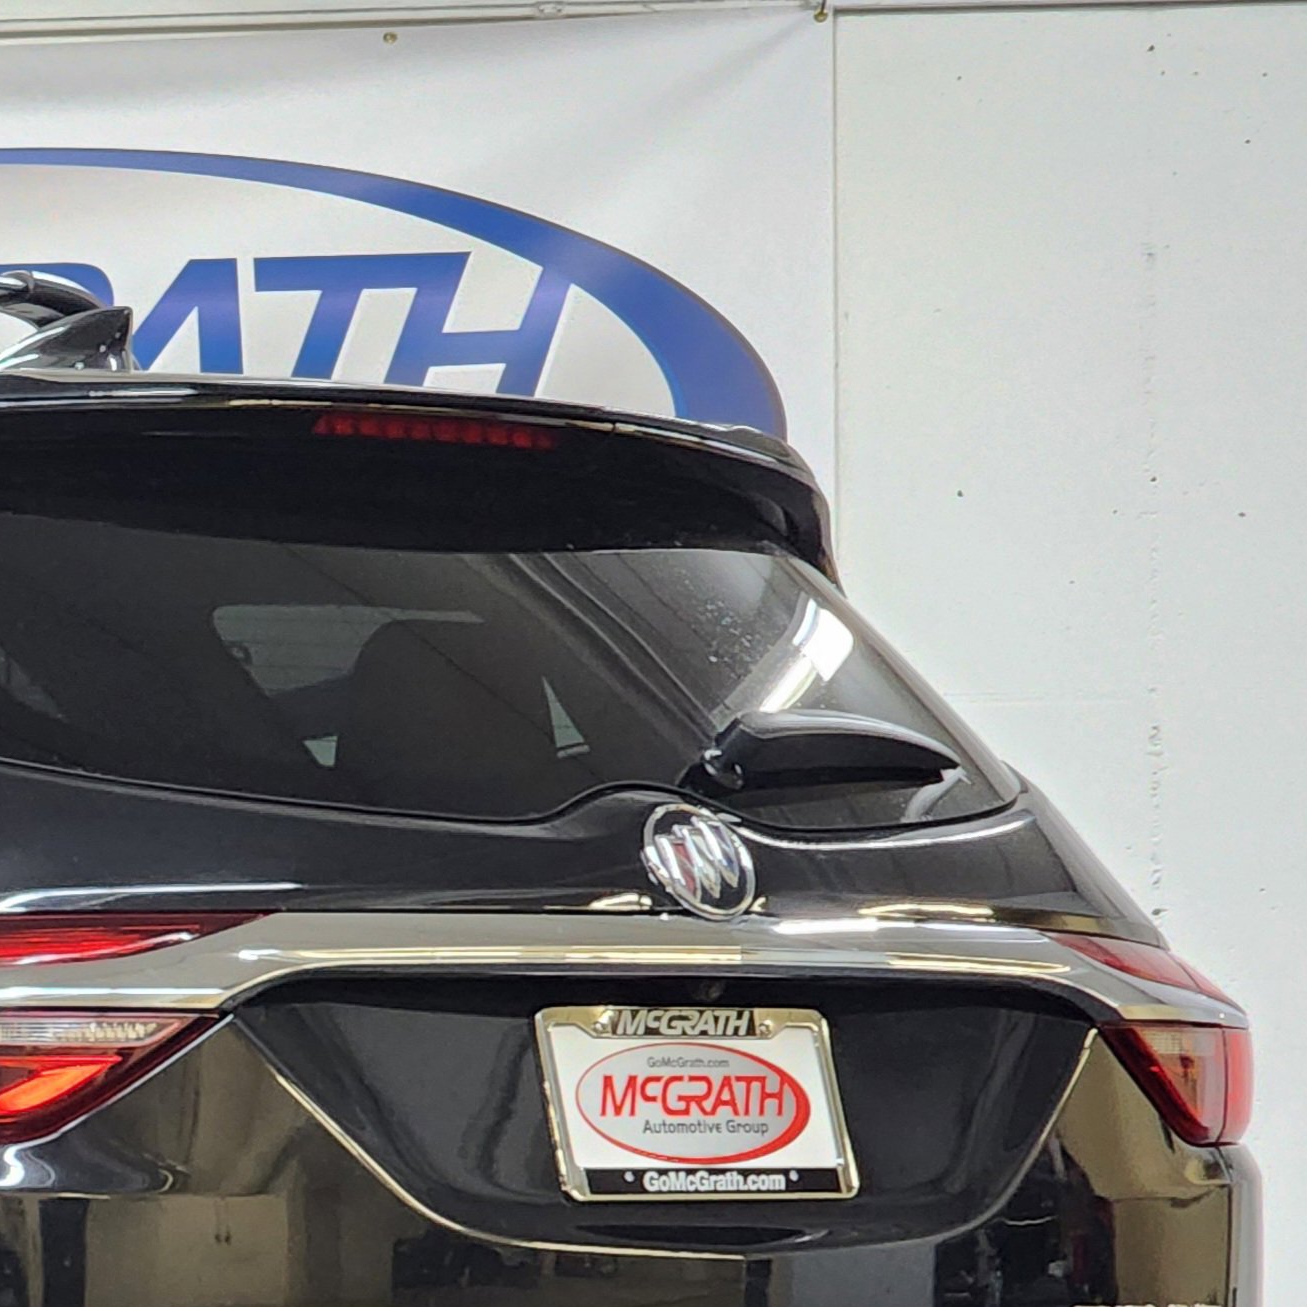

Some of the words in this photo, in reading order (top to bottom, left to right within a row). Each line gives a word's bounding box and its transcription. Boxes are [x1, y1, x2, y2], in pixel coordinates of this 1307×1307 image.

[646, 1056, 730, 1069] GoMcGrath.com
[642, 1119, 722, 1135] Automotive
[725, 1120, 769, 1137] Group
[643, 1170, 786, 1192] GoMcGrath.com
